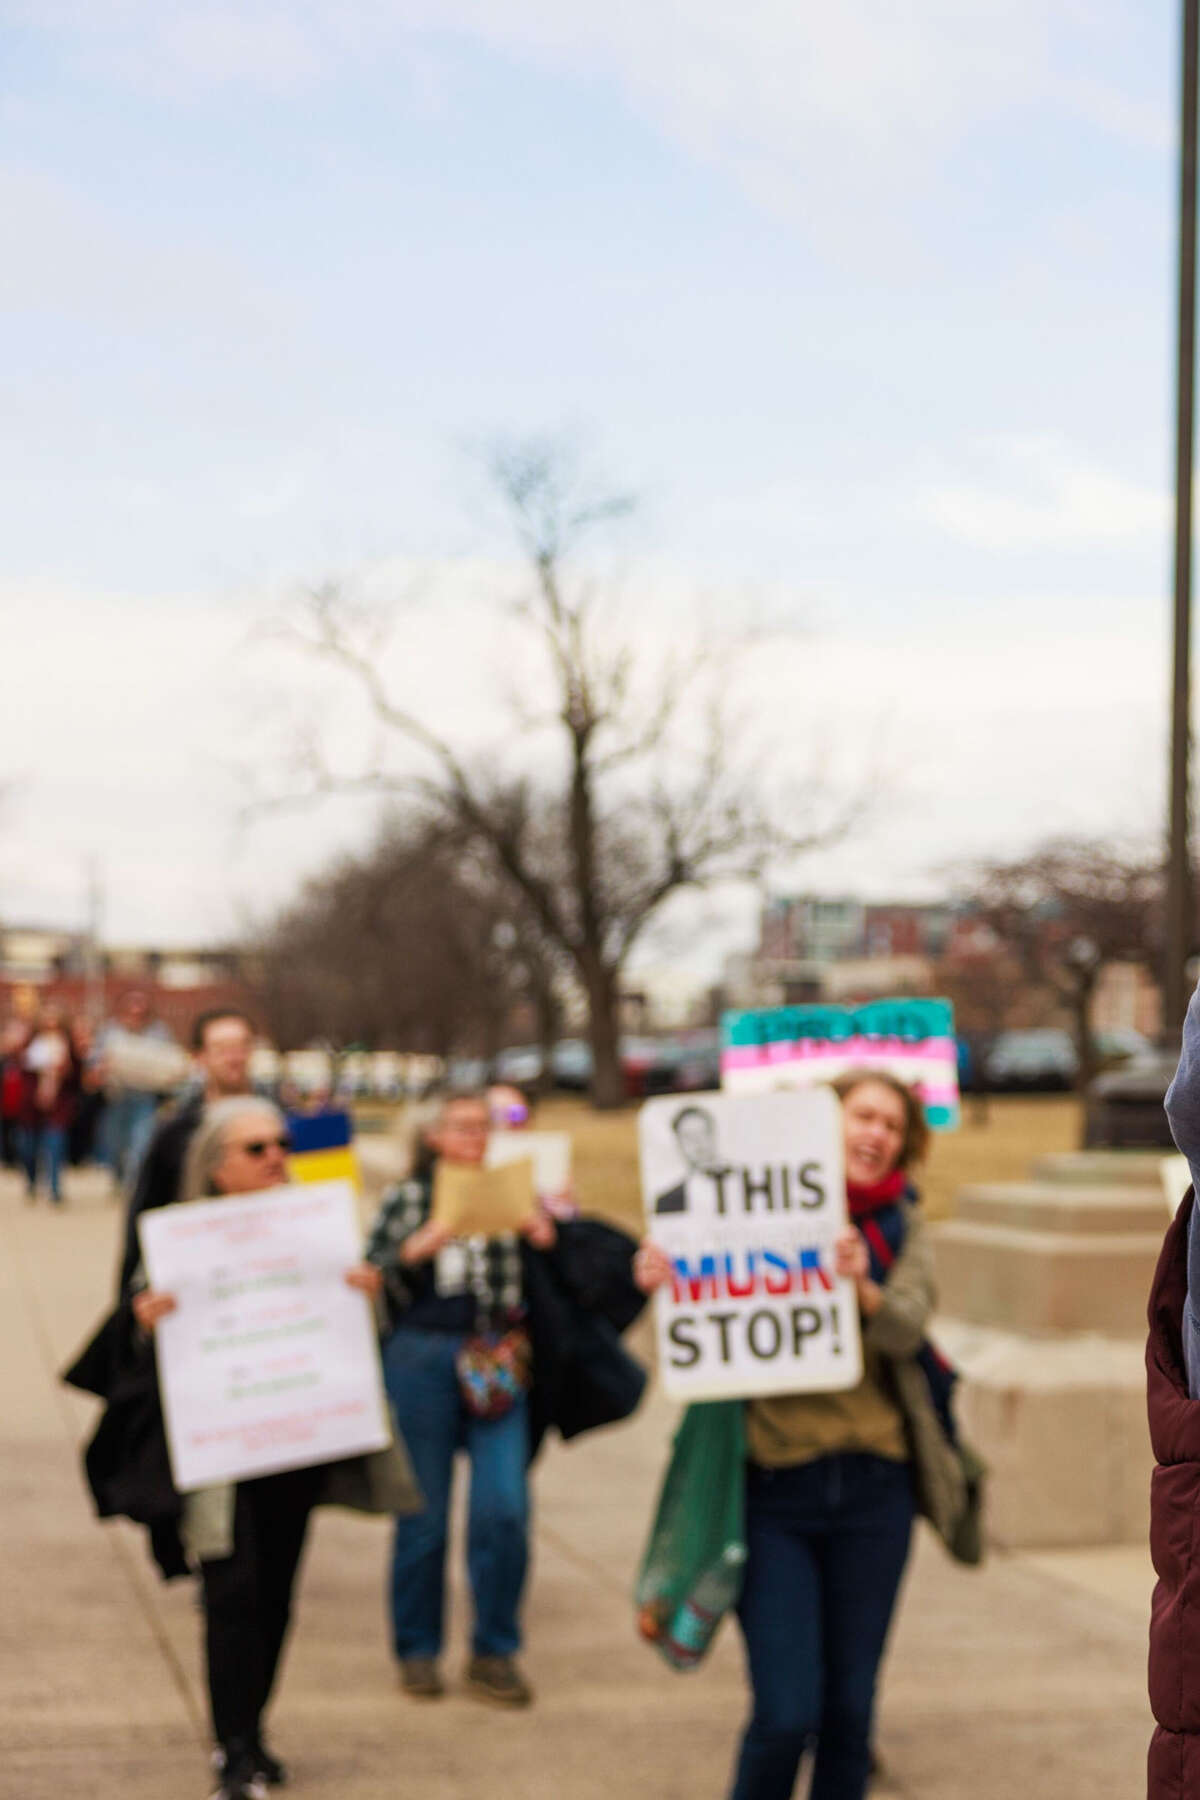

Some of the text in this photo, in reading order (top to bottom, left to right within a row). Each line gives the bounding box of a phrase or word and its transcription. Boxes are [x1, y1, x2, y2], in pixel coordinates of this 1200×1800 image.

[704, 1162, 826, 1216] THIS
[672, 1244, 833, 1304] MUSK
[668, 1304, 842, 1370] STOP!
